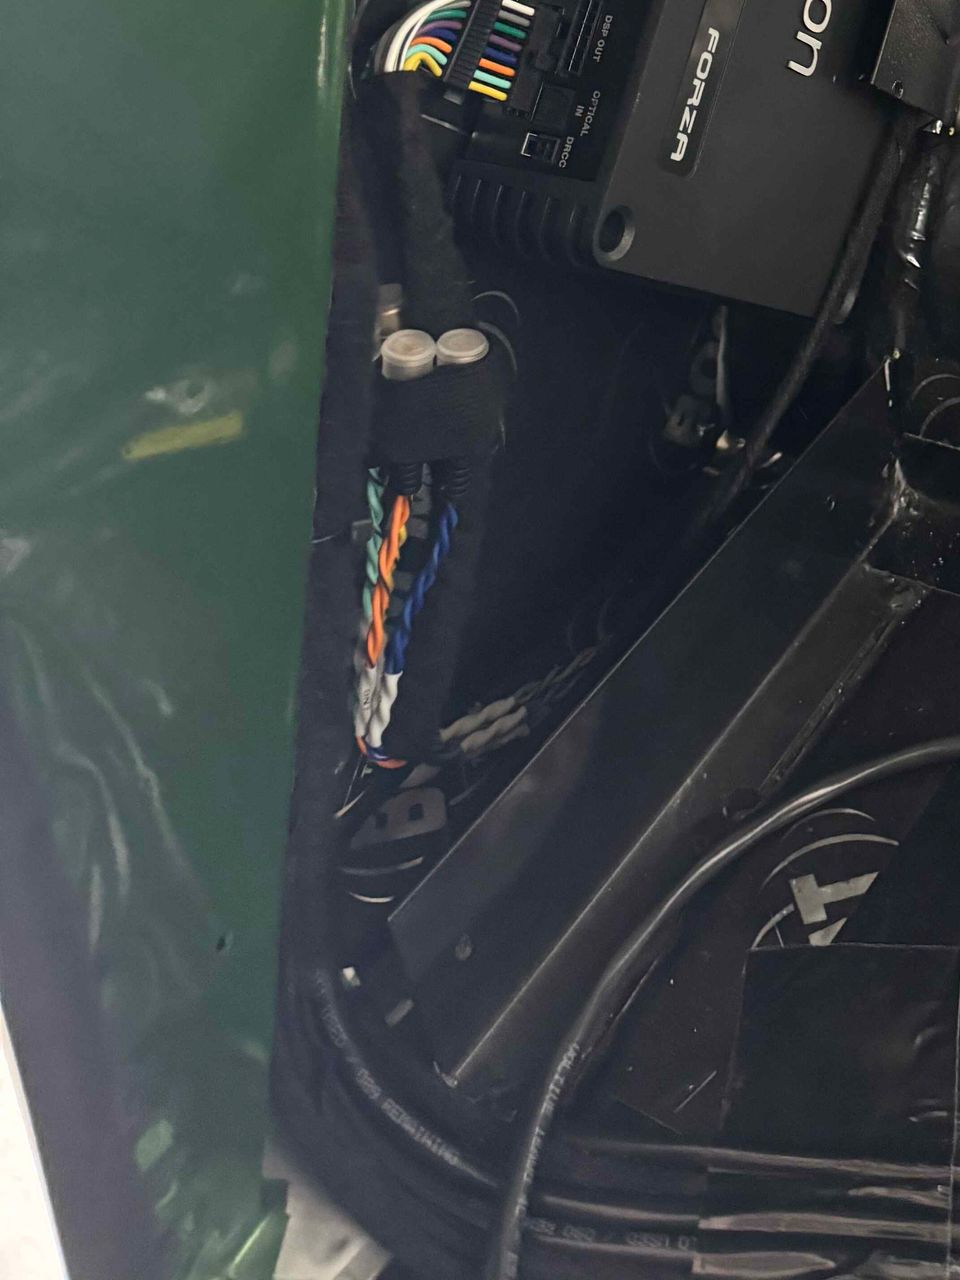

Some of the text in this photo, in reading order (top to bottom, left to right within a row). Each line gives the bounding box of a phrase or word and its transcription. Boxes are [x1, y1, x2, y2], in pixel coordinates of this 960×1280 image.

[592, 14, 613, 63] DSP OUT
[574, 104, 585, 118] IN
[580, 89, 601, 137] OPTICAL
[670, 26, 721, 164] FORZA
[558, 135, 575, 169] DRCC
